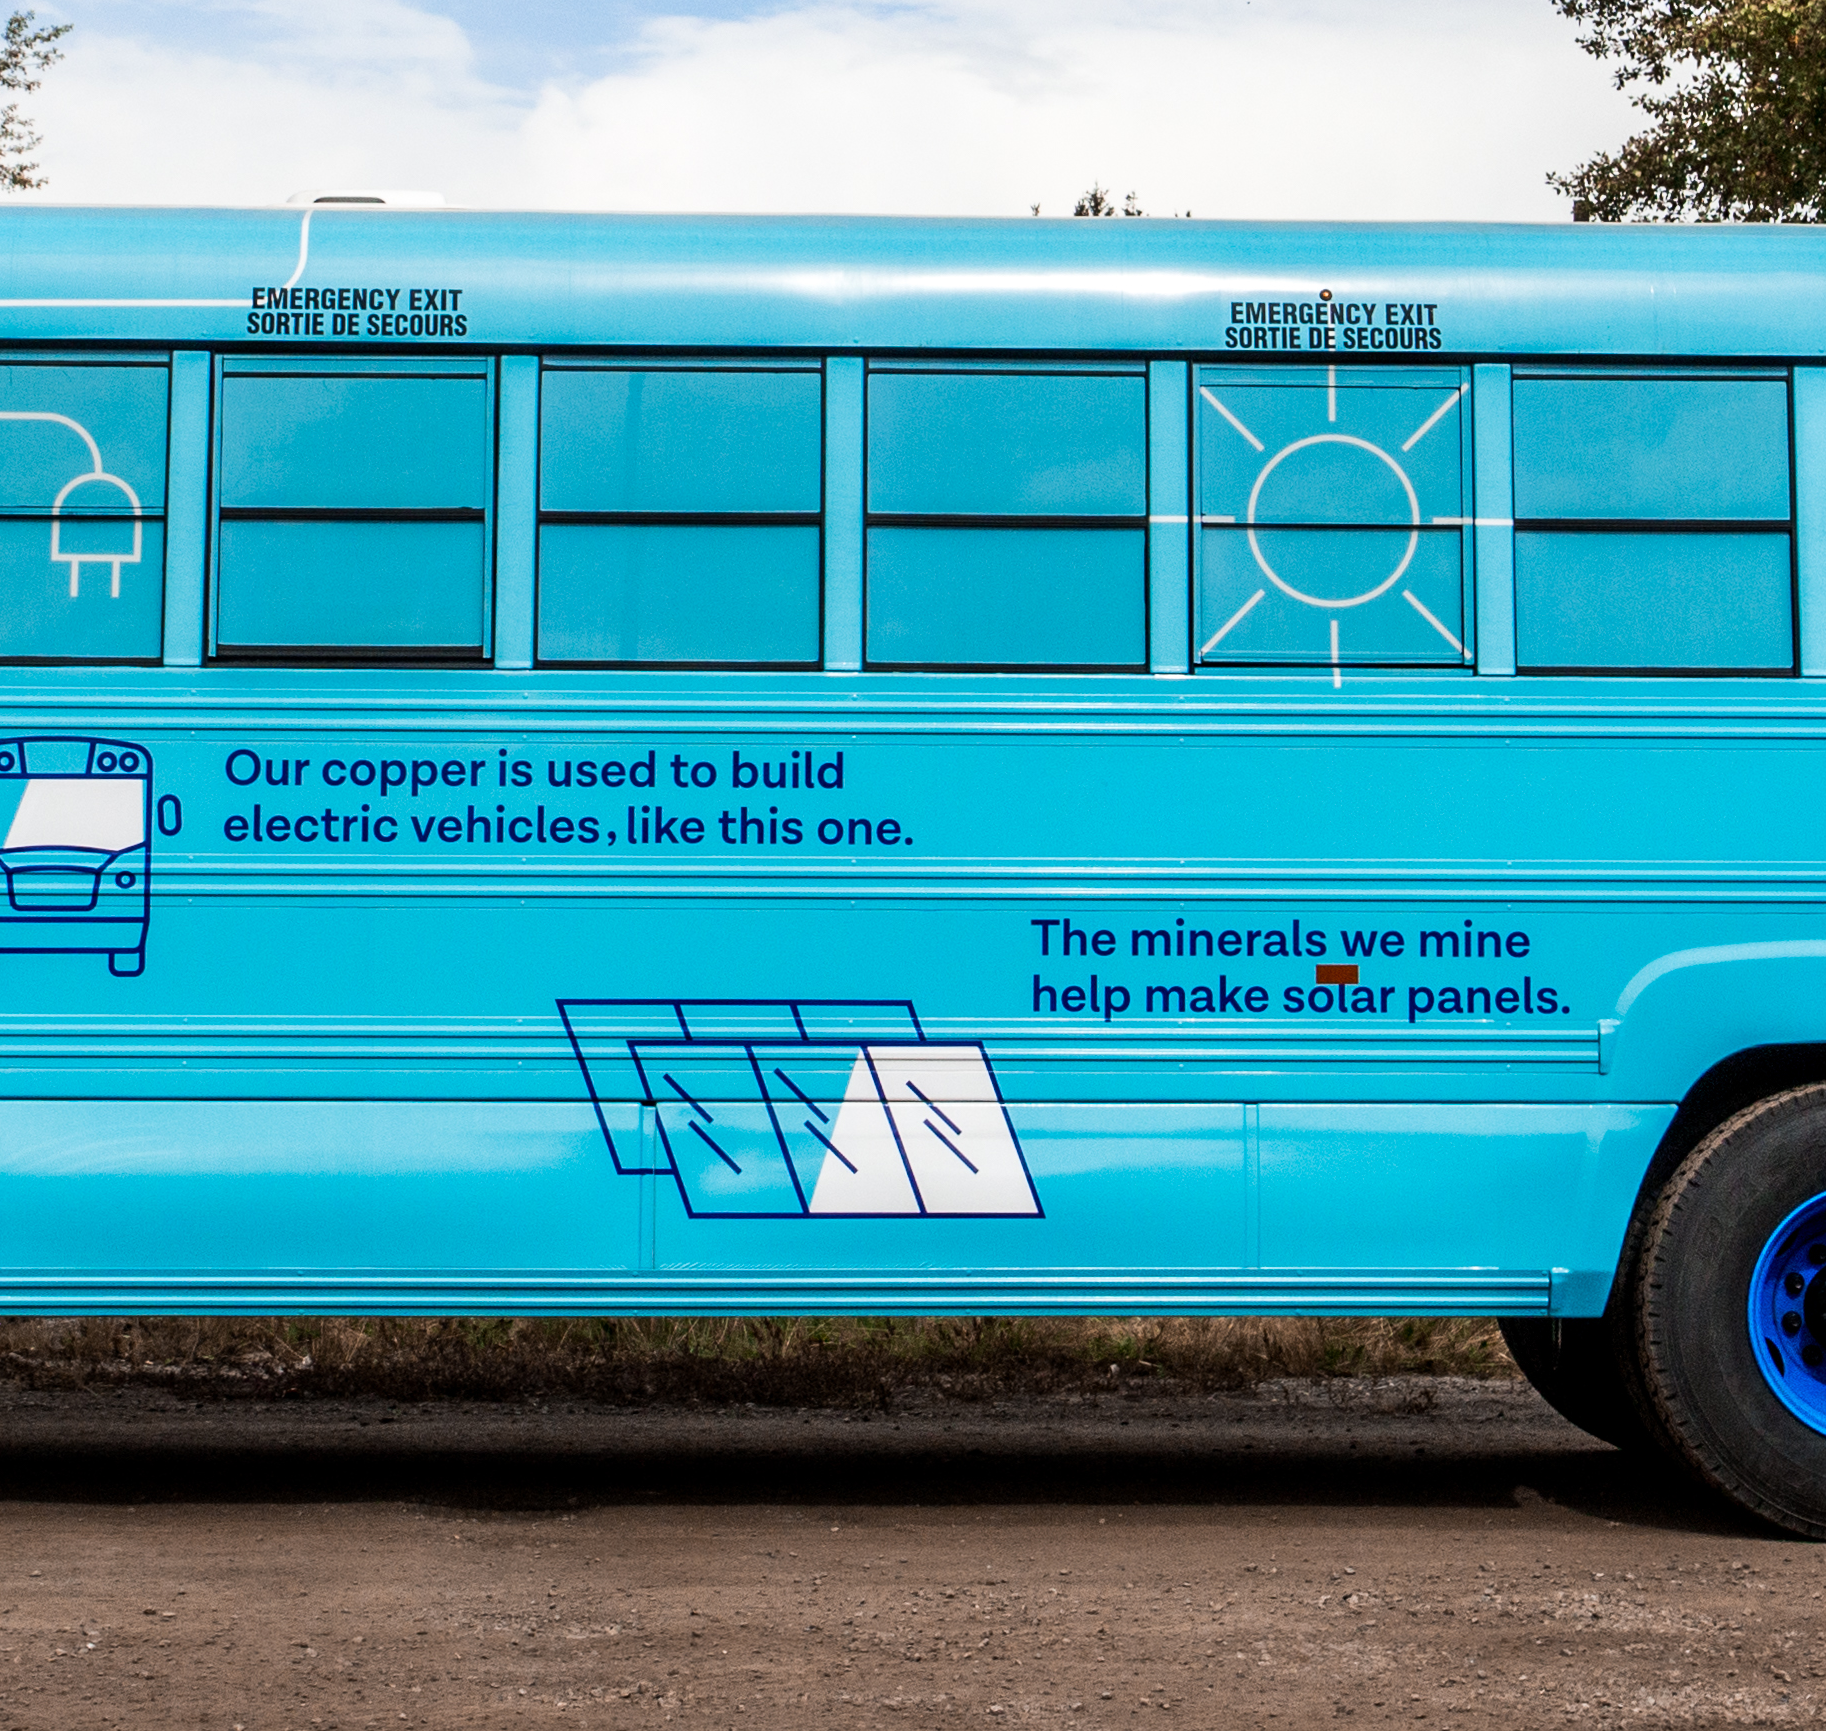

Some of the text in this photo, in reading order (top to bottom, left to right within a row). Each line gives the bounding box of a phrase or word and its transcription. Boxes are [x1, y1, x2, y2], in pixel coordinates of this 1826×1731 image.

[252, 287, 462, 311] EMERGENCY EXIT
[1231, 302, 1438, 326] EMERGENCY EXIT
[247, 312, 467, 337] SORTIE DE SECOURS
[1225, 327, 1442, 350] SORTIE DE SECOURS
[225, 748, 844, 797] Our copper is used to build
[223, 803, 914, 847] electric vehicles, like this one.
[1030, 917, 1531, 958] The minerals we mine
[1032, 974, 1571, 1024] help make solar panels.
